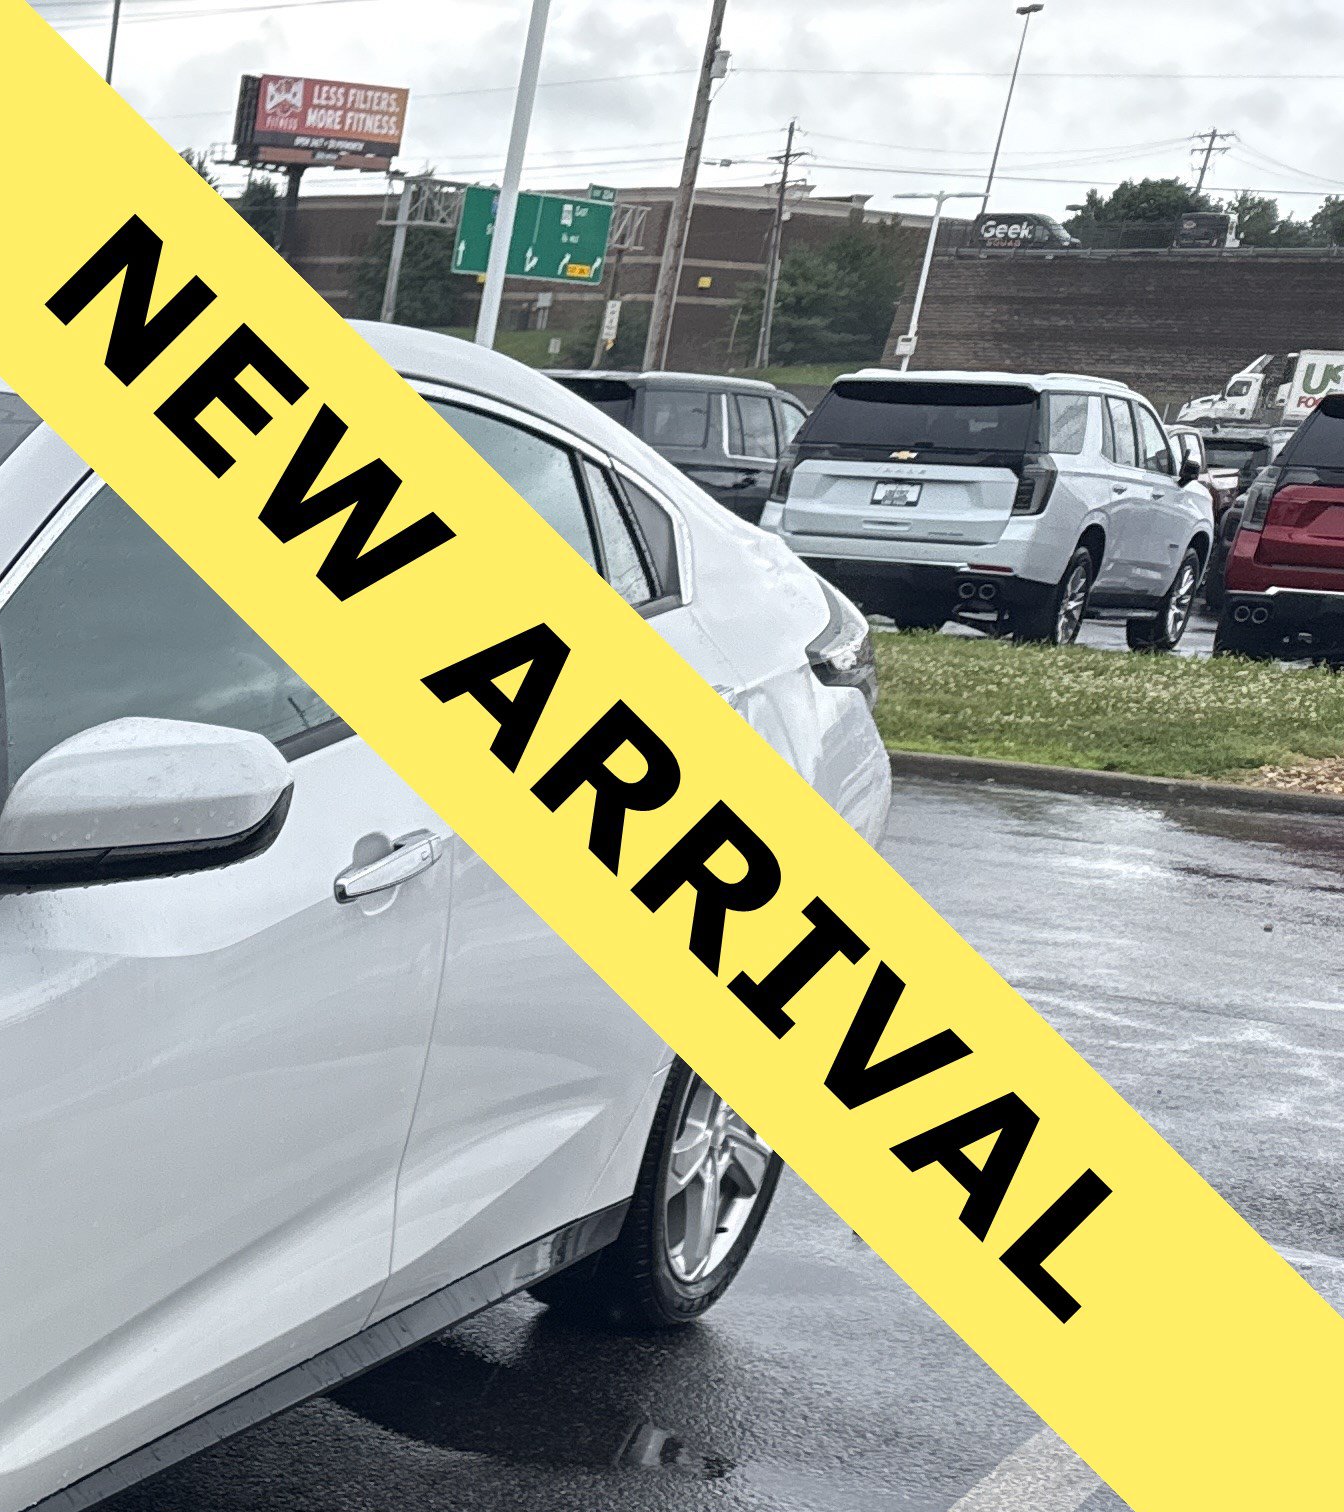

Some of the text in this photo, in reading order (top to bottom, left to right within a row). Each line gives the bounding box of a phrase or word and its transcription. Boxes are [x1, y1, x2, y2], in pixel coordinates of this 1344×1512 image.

[313, 84, 400, 113] LESS FILTERS.
[305, 107, 400, 135] MORE FITNESS.
[980, 220, 1034, 239] Geek
